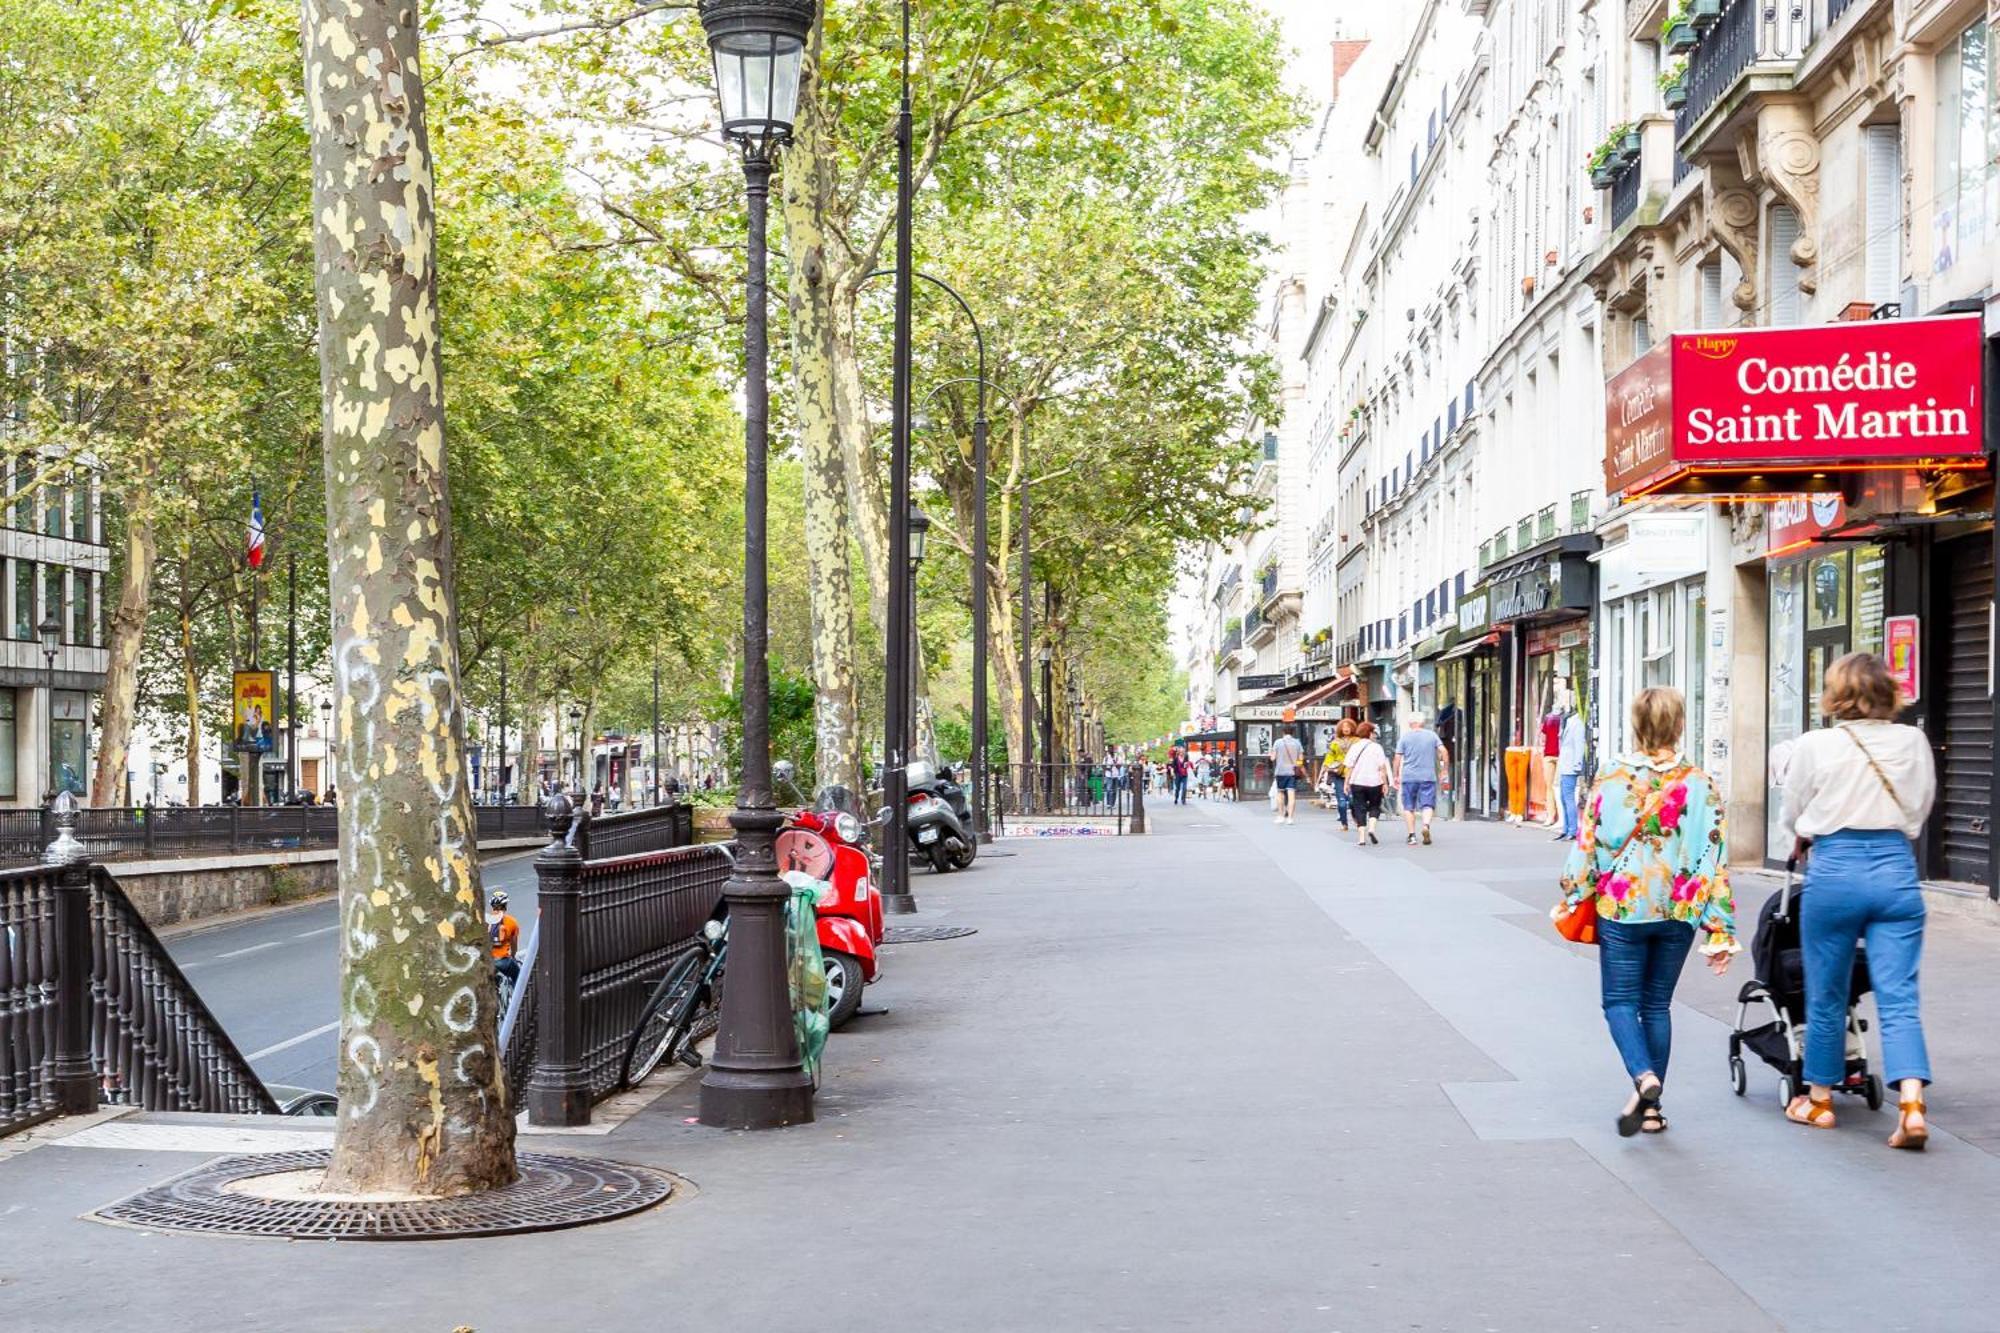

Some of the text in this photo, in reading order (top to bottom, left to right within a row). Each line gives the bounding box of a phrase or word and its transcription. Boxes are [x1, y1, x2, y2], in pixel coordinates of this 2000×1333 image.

[1696, 336, 1738, 356] Happy
[1737, 352, 1917, 395] Comédie
[1686, 397, 1969, 445] Saint Martin
